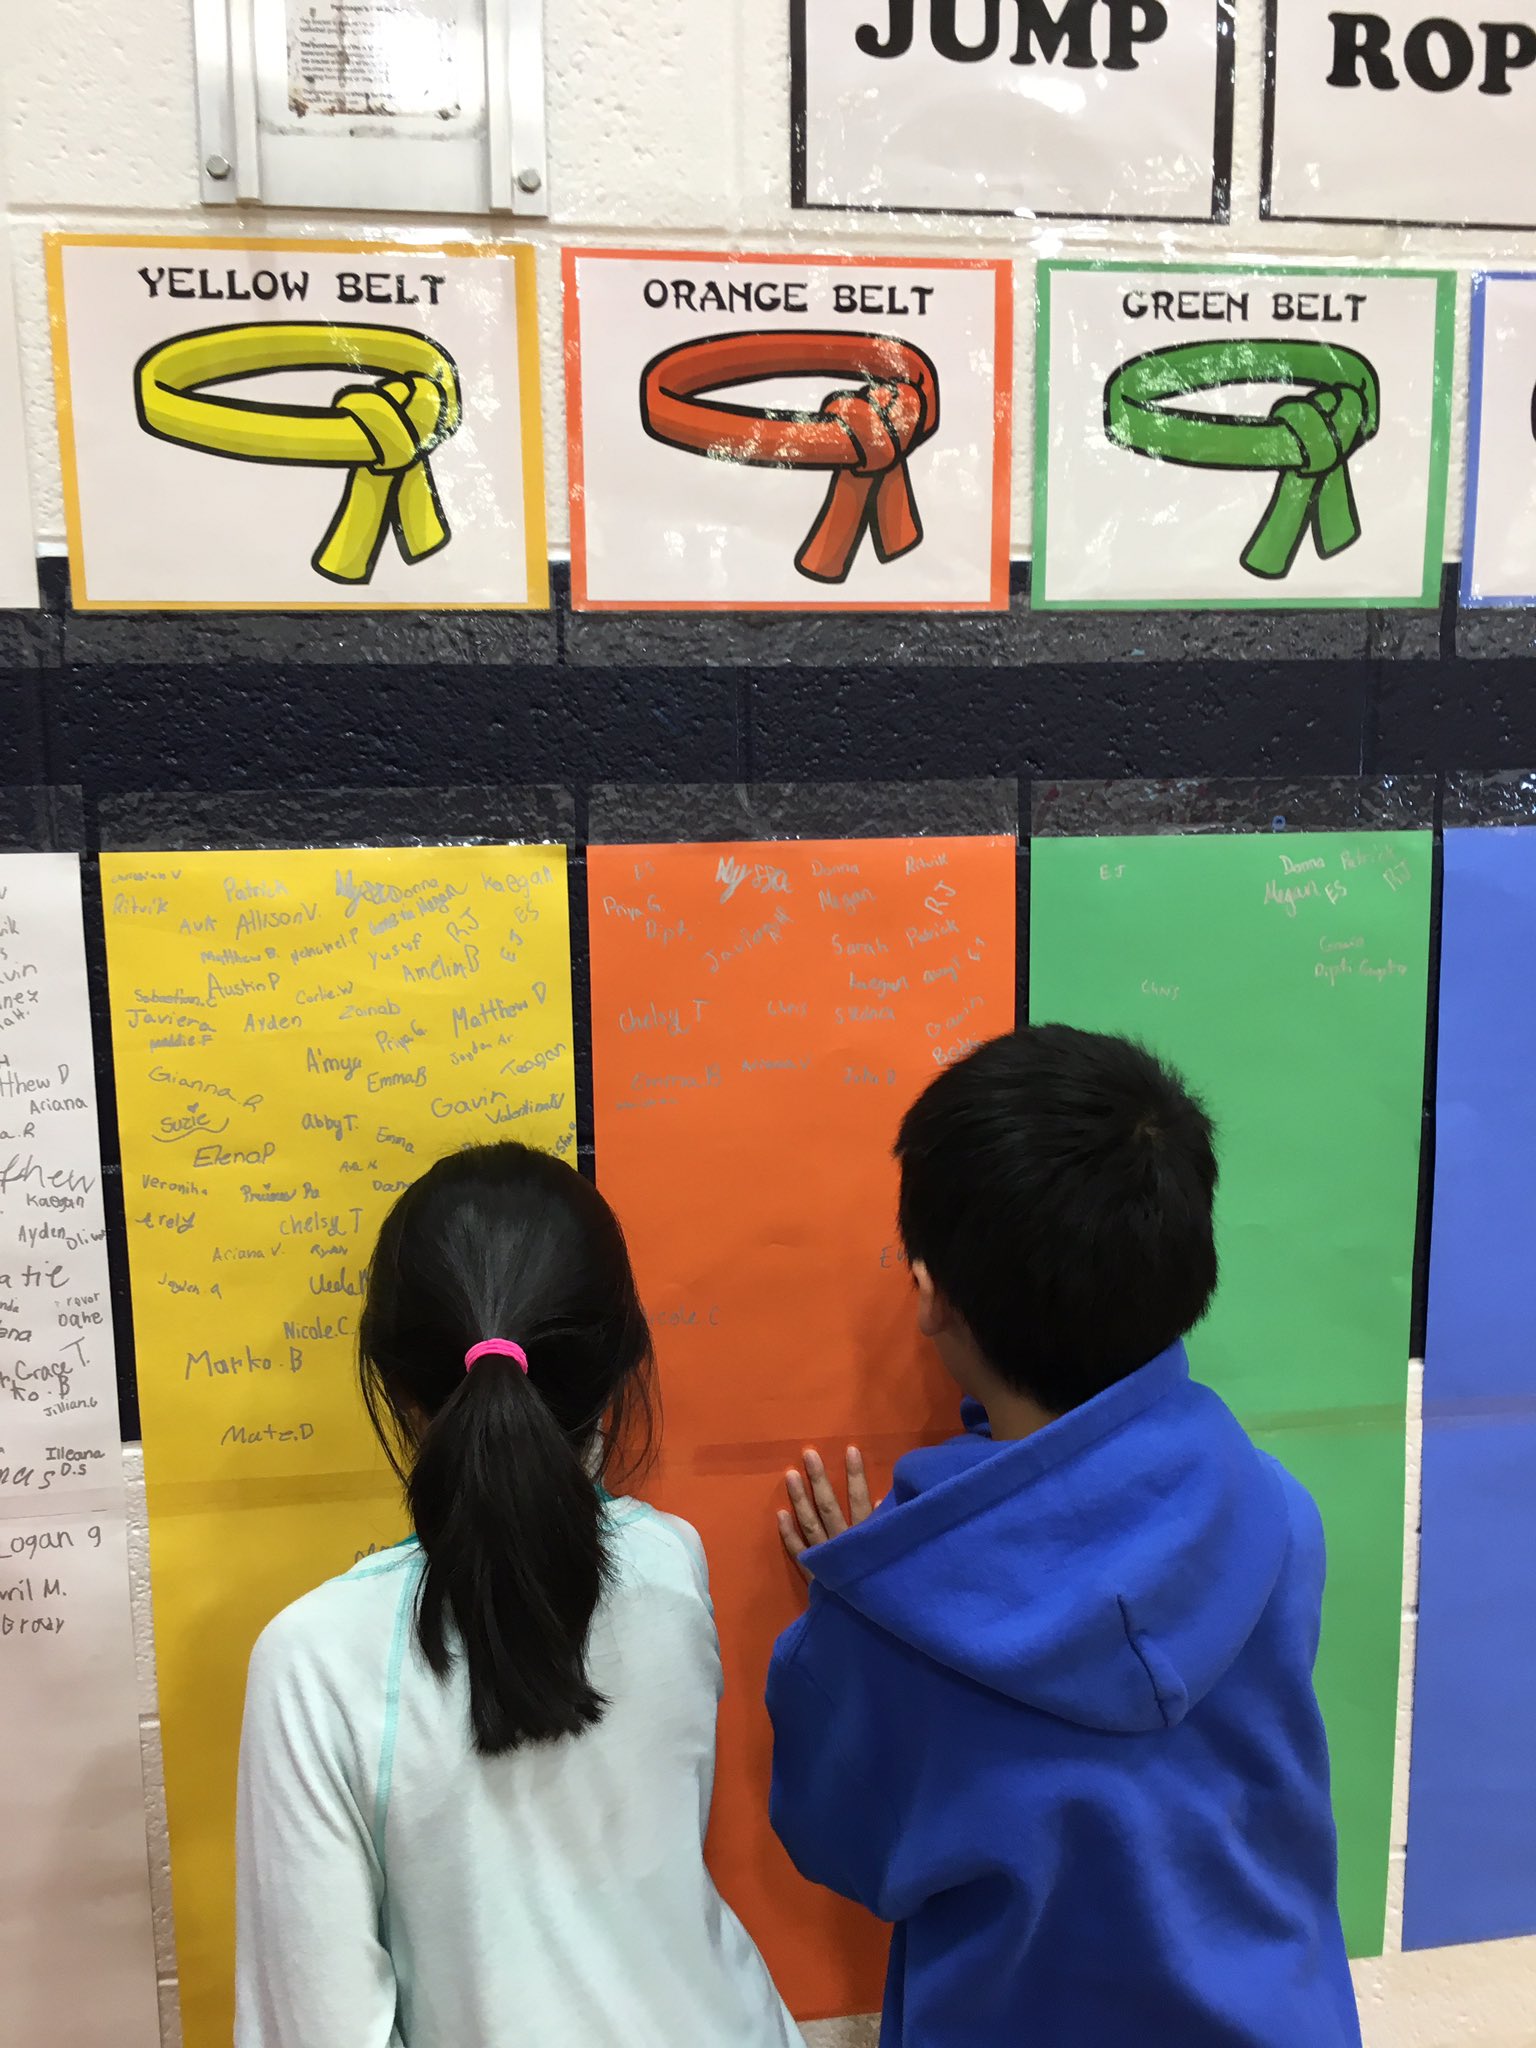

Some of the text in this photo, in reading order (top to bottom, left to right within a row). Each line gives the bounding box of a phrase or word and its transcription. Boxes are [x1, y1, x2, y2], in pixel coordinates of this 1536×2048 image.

[855, 0, 1168, 70] JUMP
[138, 267, 446, 305] YELLOW BELT
[643, 279, 934, 315] ORANGE BELT
[1122, 290, 1367, 322] GREEN BELT
[30, 1097, 88, 1115] Ariana
